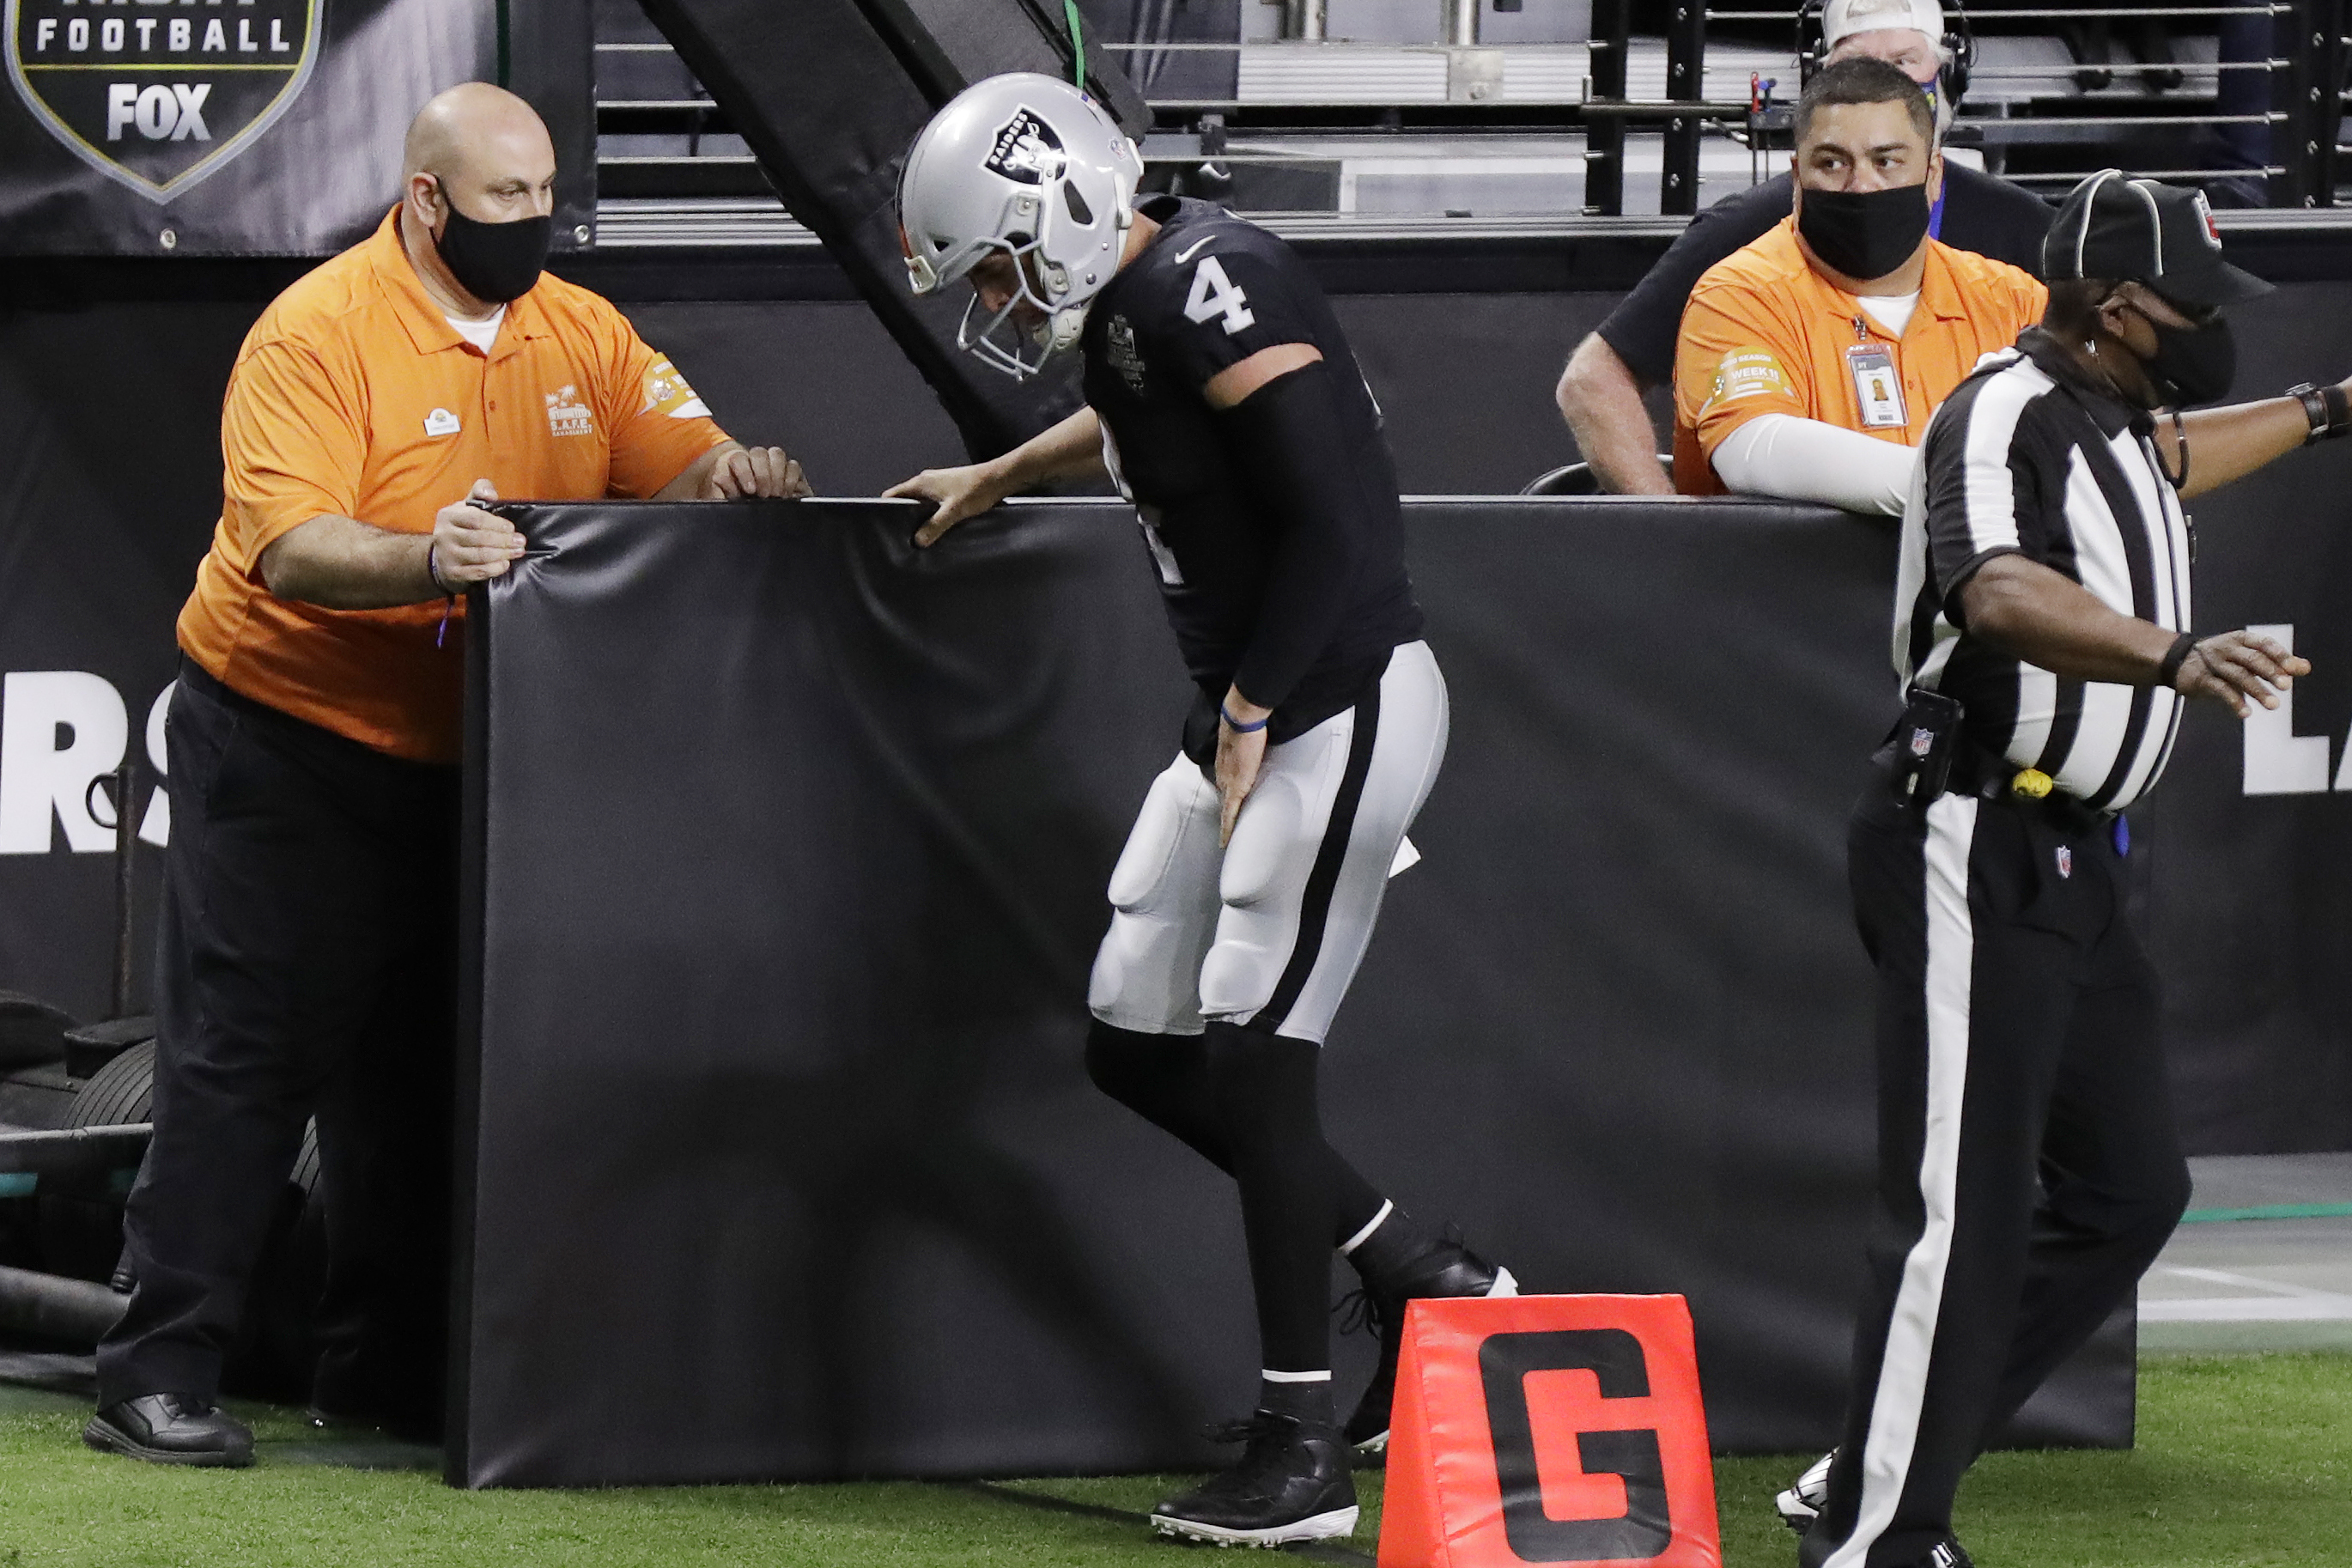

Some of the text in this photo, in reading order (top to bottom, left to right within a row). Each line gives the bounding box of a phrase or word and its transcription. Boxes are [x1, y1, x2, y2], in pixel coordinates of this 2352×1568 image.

[36, 18, 290, 52] FOOTBALL
[106, 83, 212, 142] FOX
[989, 112, 1029, 167] RAIDERS
[1184, 255, 1256, 336] 4
[1731, 367, 1769, 380] WEEK
[1737, 354, 1772, 362] SEASON
[1478, 1328, 1671, 1564] G
